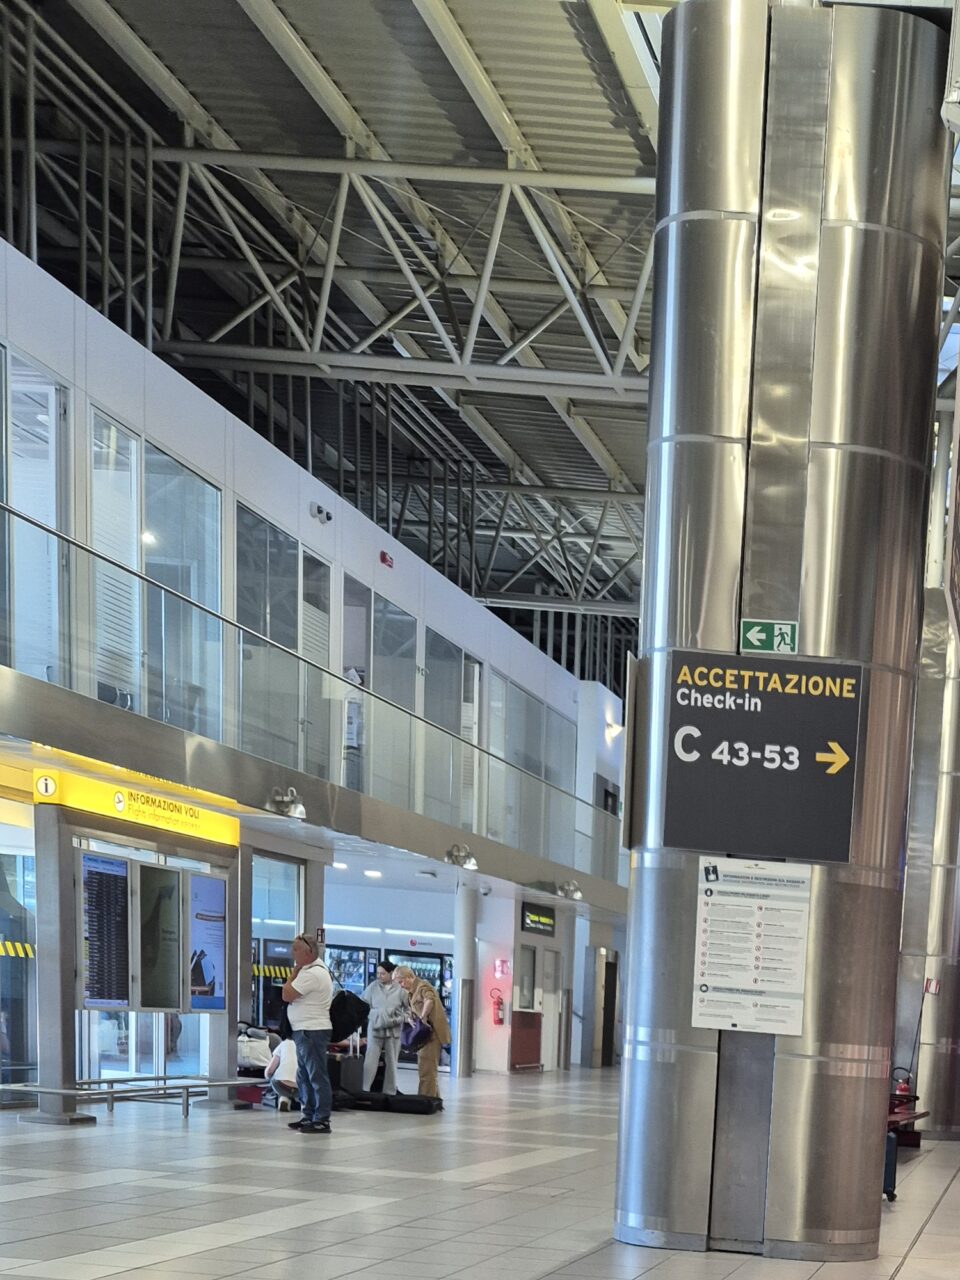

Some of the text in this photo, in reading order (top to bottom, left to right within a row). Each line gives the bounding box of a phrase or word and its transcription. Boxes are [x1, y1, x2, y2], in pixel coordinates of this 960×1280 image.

[676, 665, 857, 699] ACCETTAZIONE
[676, 687, 762, 712] Check-in
[673, 725, 800, 771] C 43-53
[128, 791, 200, 819] INFORMAZIONI VOLI
